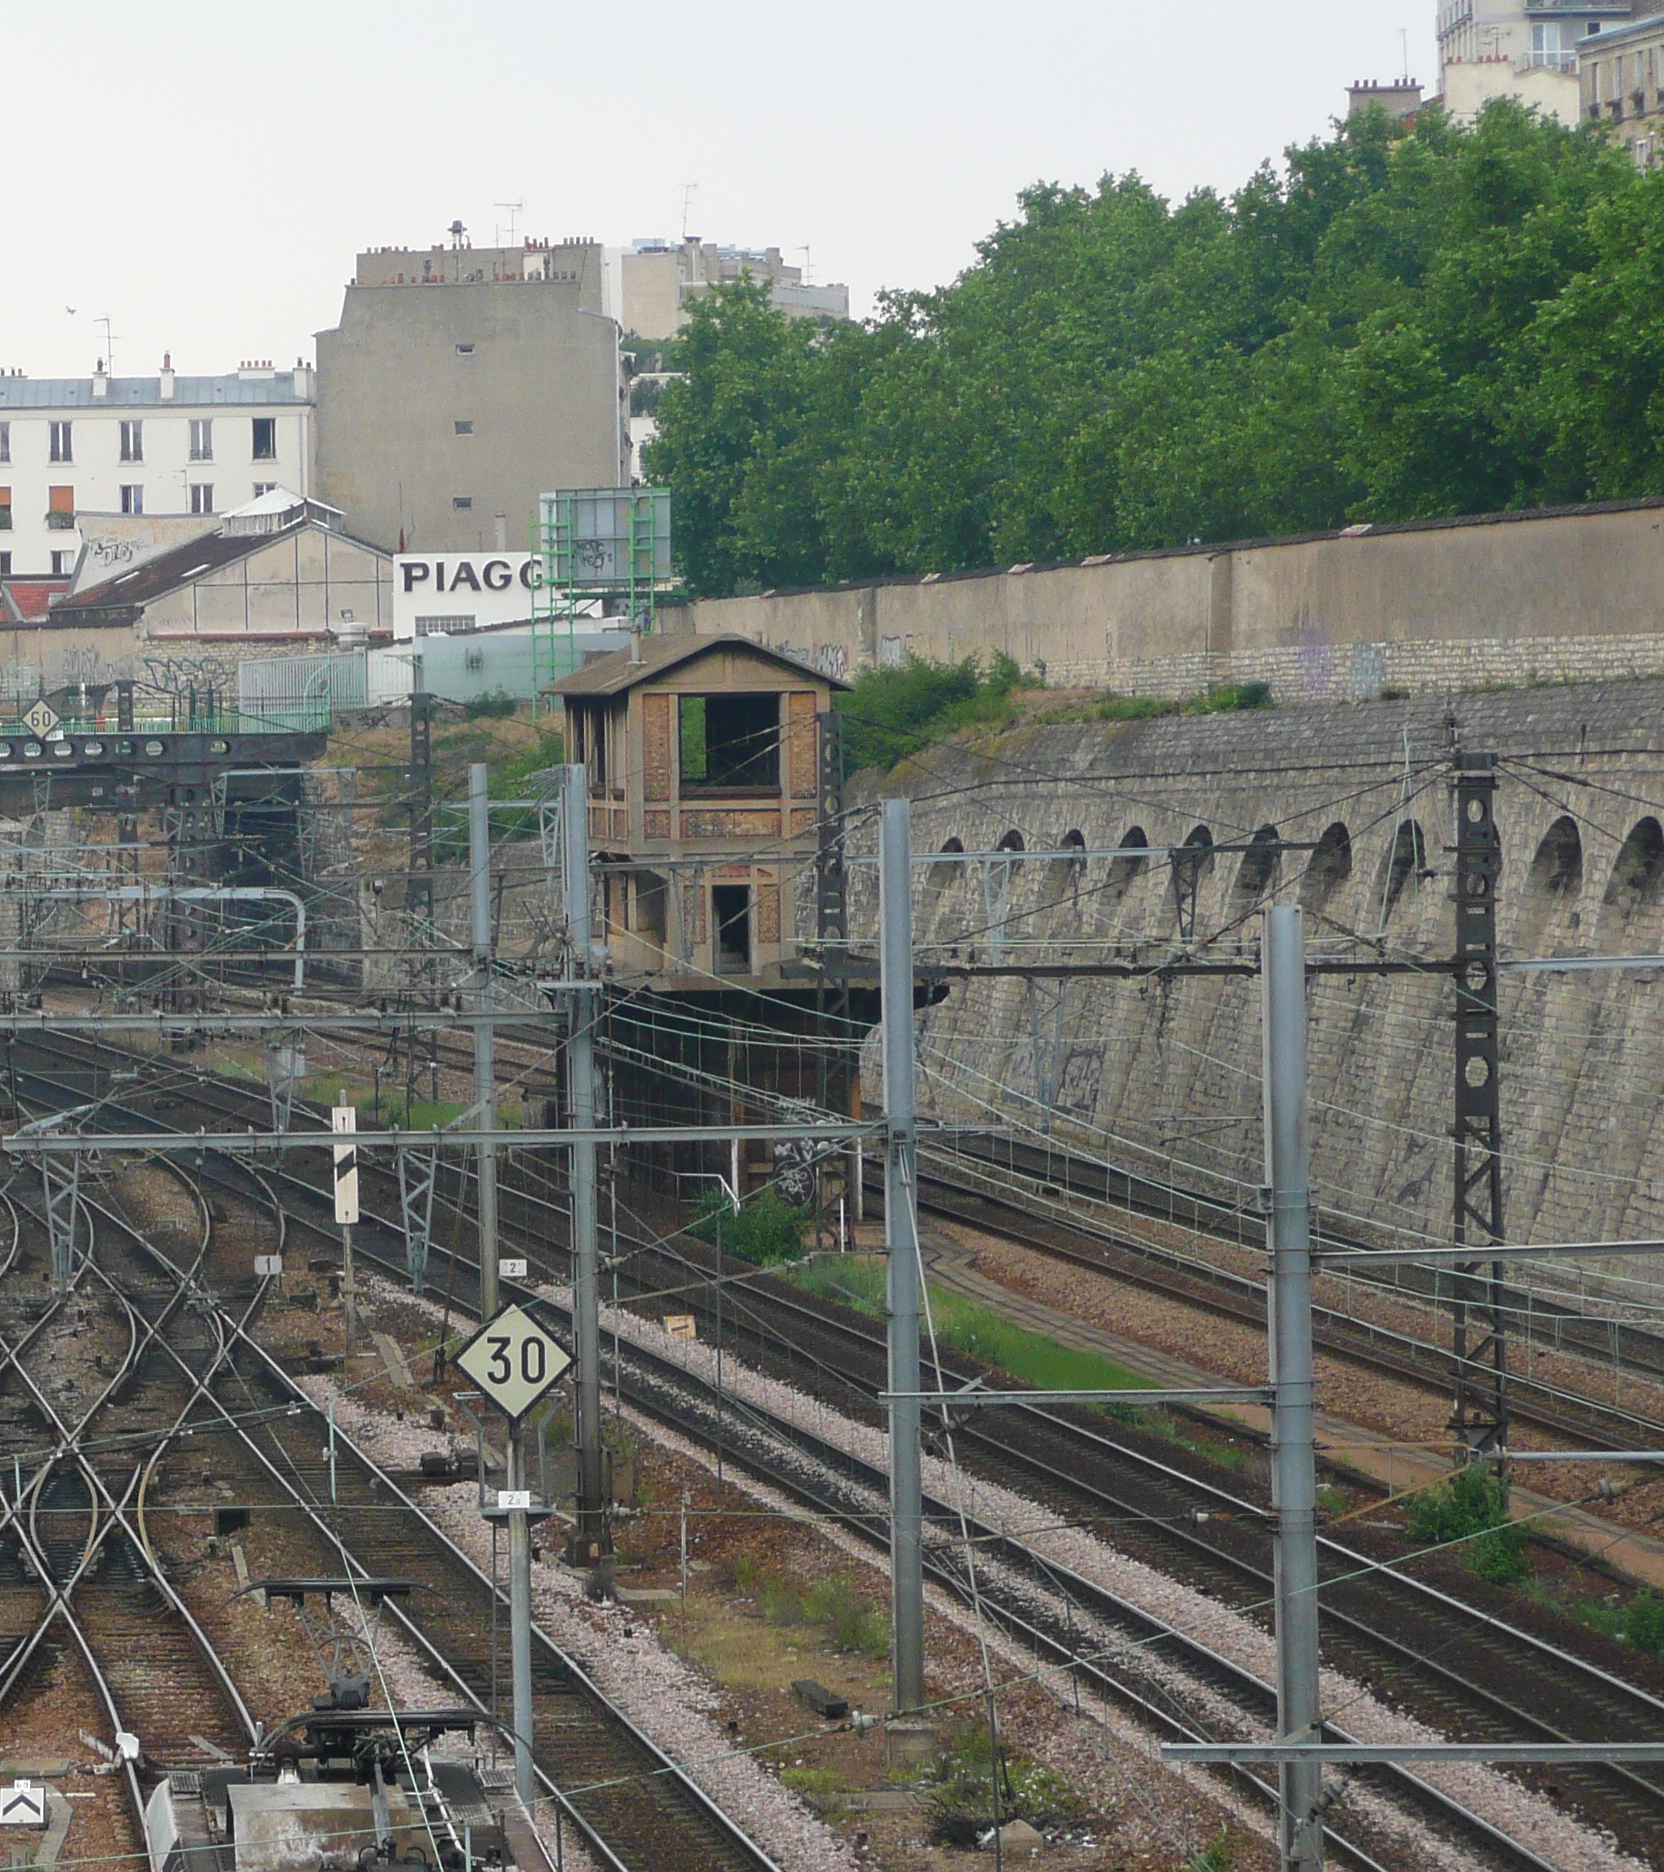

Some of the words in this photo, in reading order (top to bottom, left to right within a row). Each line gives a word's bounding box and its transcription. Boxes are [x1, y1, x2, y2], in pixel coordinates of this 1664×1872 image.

[30, 711, 51, 727] 60
[509, 1262, 517, 1274] 2
[486, 1335, 546, 1384] 30
